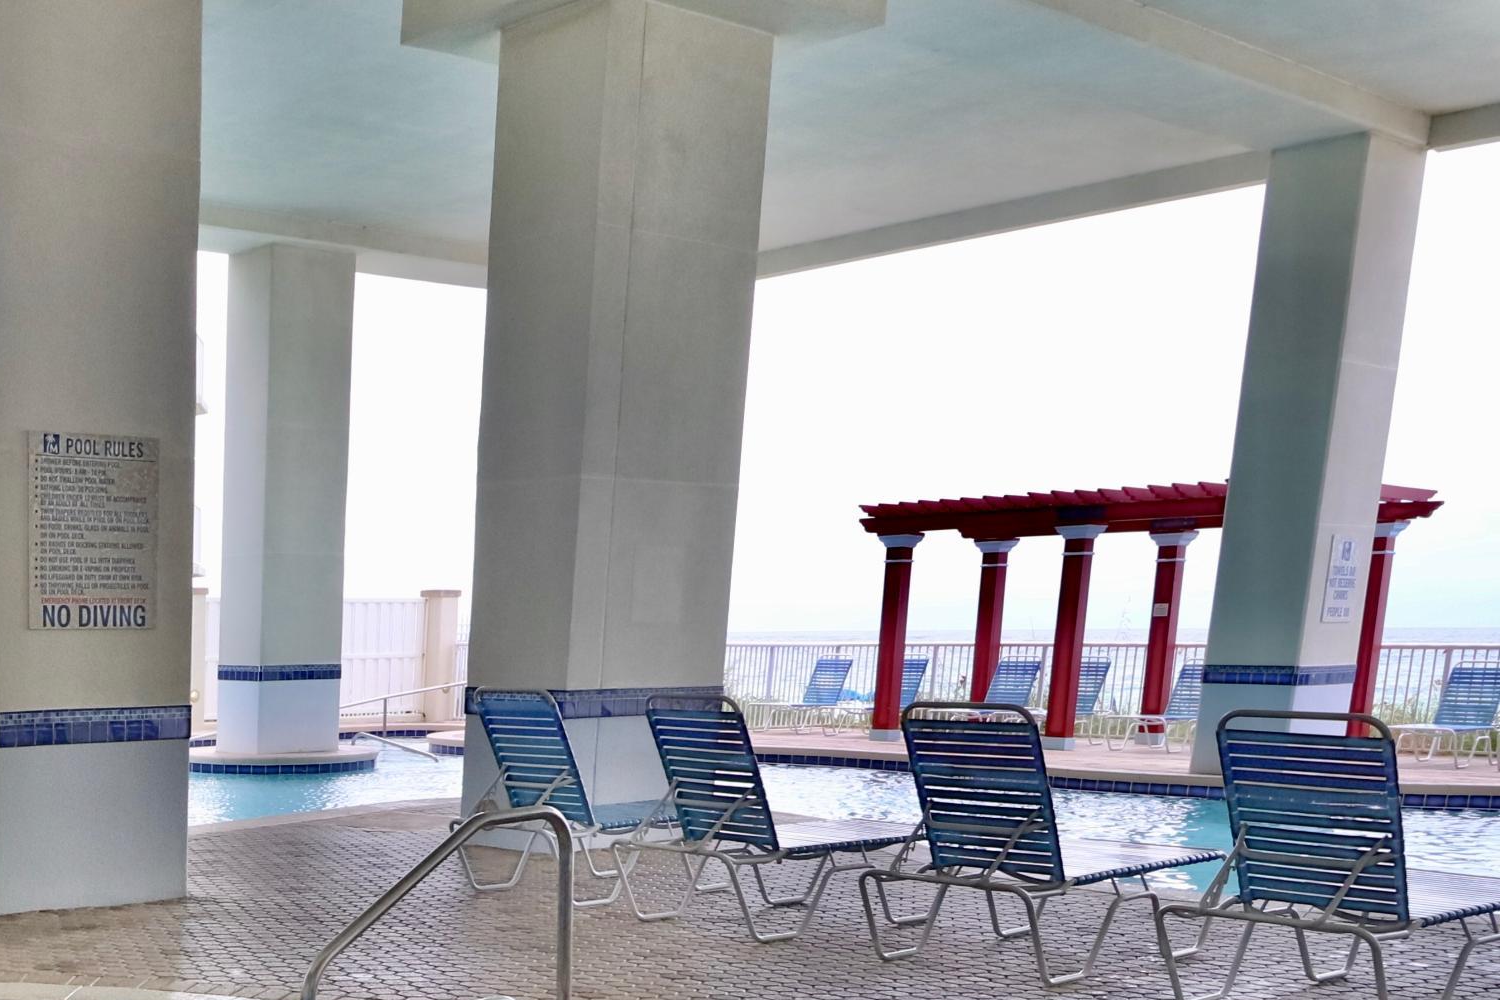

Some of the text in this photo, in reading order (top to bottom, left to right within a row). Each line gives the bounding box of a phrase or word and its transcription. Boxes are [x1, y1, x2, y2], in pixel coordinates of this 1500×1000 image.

[66, 438, 143, 458] POOL RULES
[43, 605, 146, 627] NO DIVING
